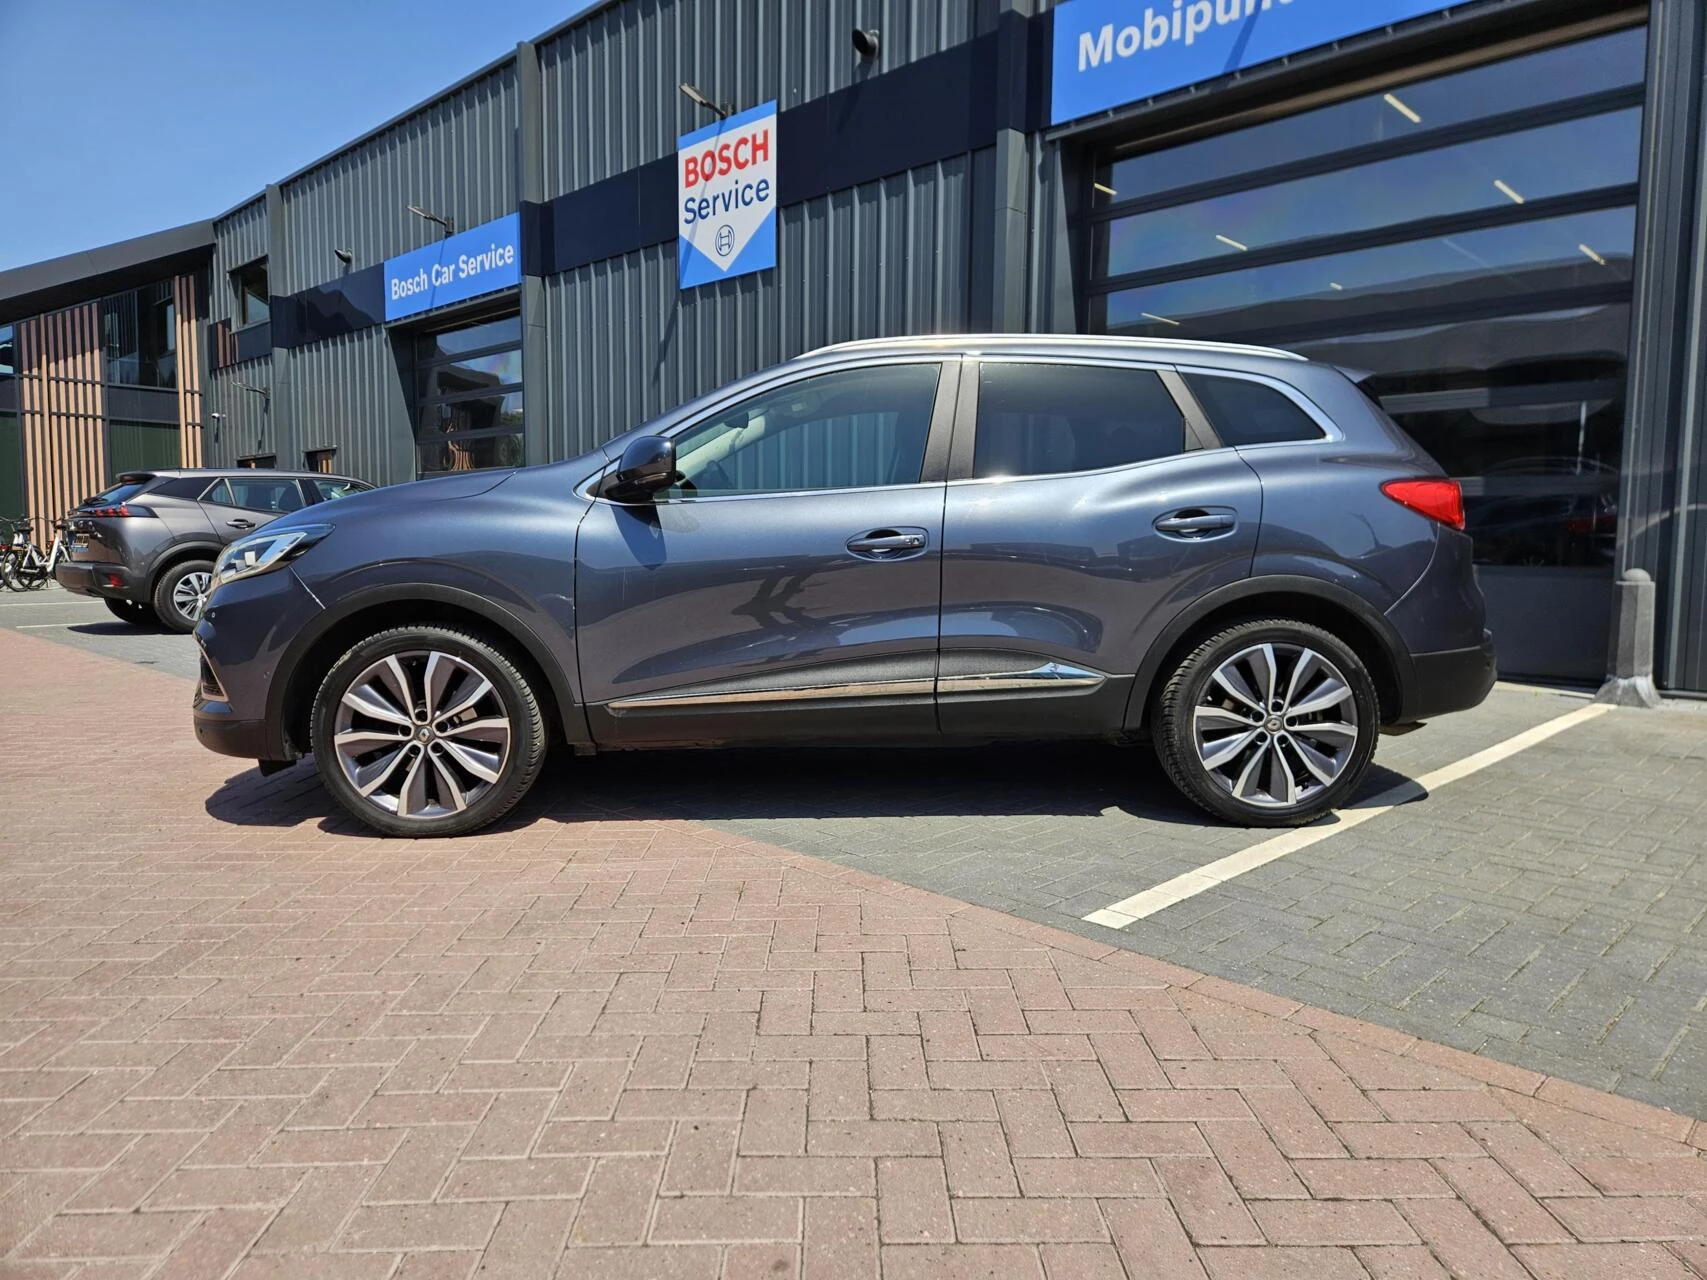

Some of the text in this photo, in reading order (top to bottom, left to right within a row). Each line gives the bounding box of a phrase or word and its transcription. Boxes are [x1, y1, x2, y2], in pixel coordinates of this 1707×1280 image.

[1077, 0, 1293, 72] Mobipu
[684, 128, 769, 188] BOSCH
[684, 178, 770, 225] Service
[391, 243, 514, 300] Bosch Car Service
